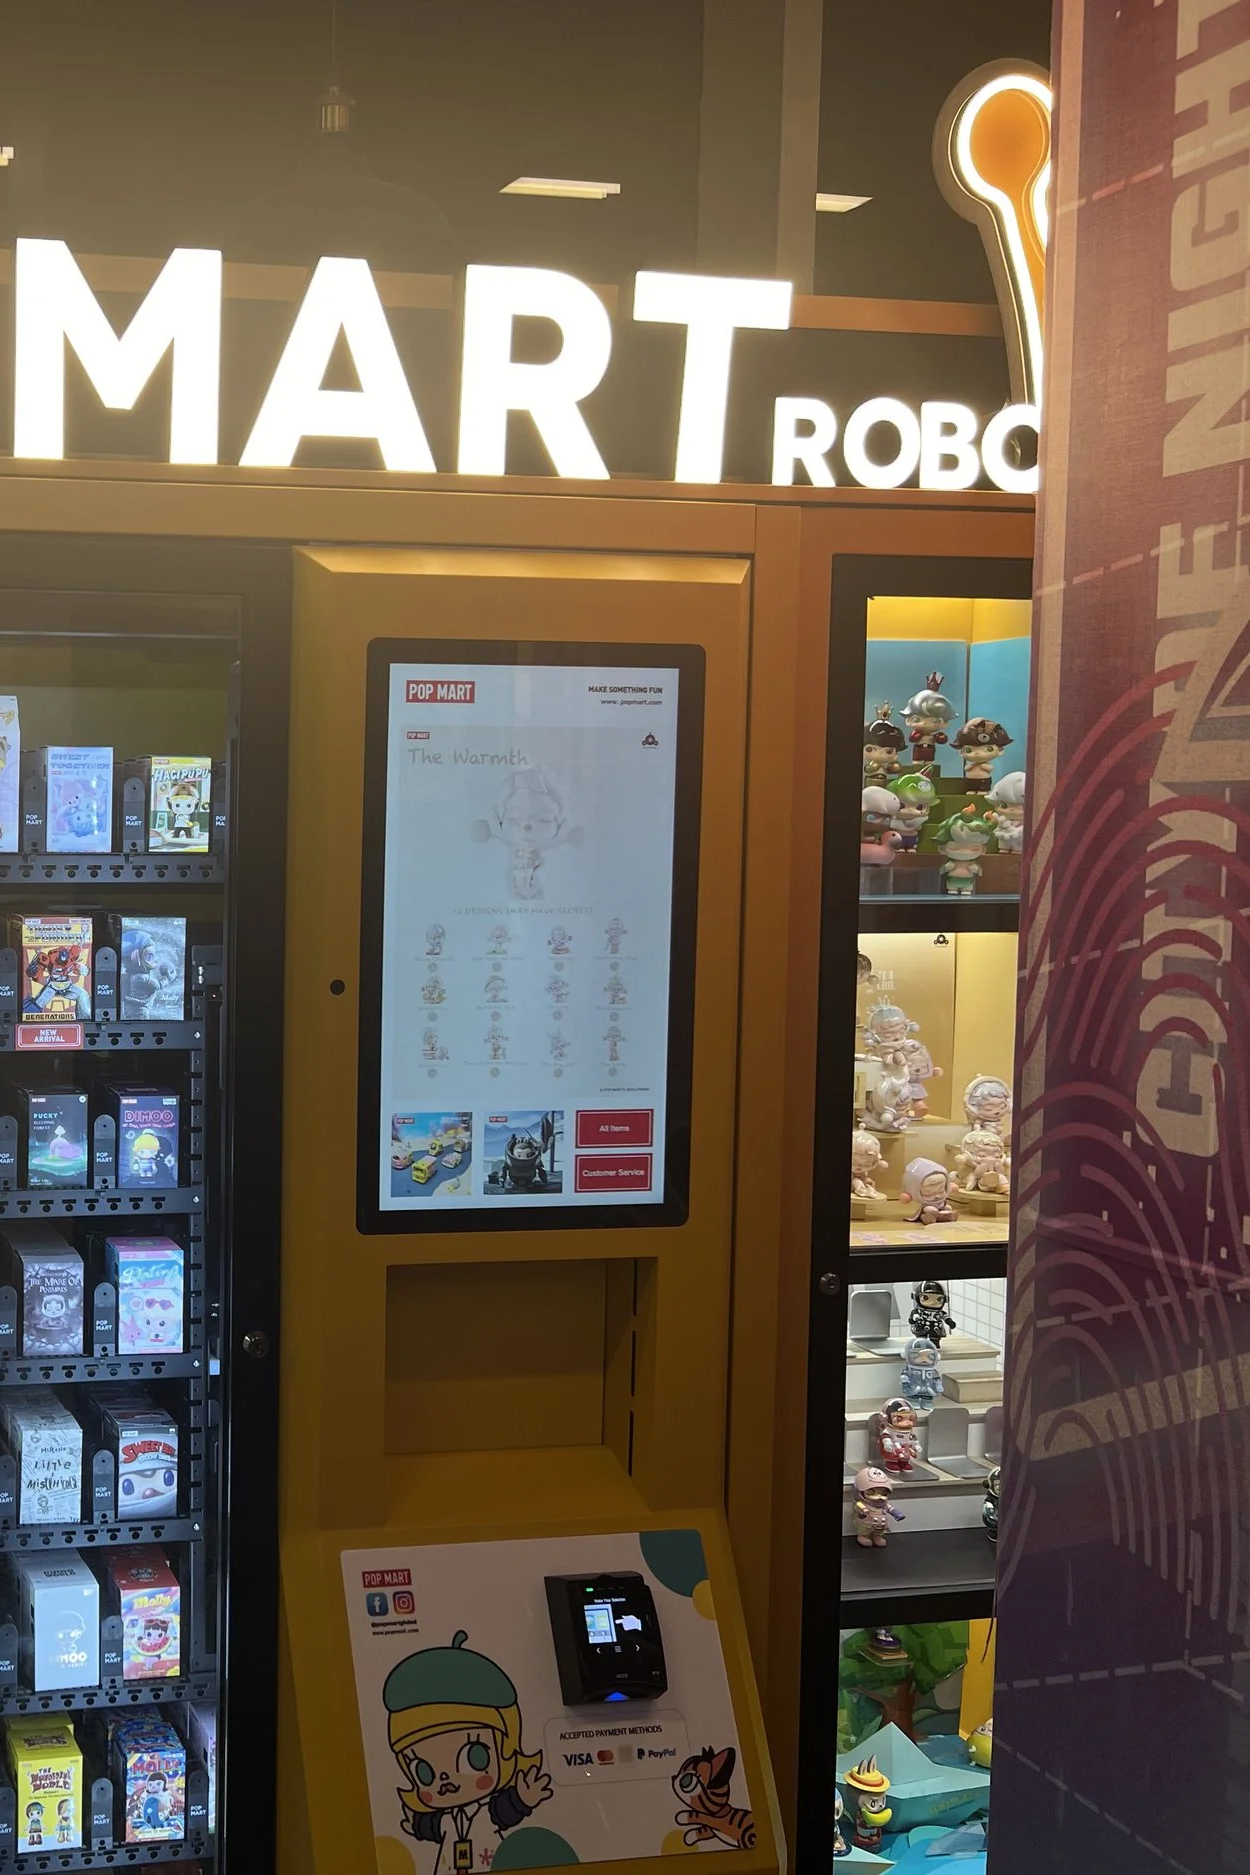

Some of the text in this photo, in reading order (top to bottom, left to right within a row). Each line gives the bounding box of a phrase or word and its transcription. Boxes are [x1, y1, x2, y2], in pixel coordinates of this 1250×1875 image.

[13, 237, 793, 484] MART
[408, 683, 473, 701] POP MART
[407, 747, 528, 765] The Warmth
[124, 1110, 174, 1122] DIMOO
[582, 1169, 645, 1177] Customer Service
[121, 1440, 162, 1464] SWEET
[364, 1571, 409, 1586] POP MART
[560, 1725, 663, 1741] ACCEPTED PAYMENT METHODS
[561, 1753, 594, 1767] VISA
[648, 1748, 676, 1759] PayPal
[132, 1759, 180, 1773] MOLLY
[32, 1780, 72, 1793] WORLD
